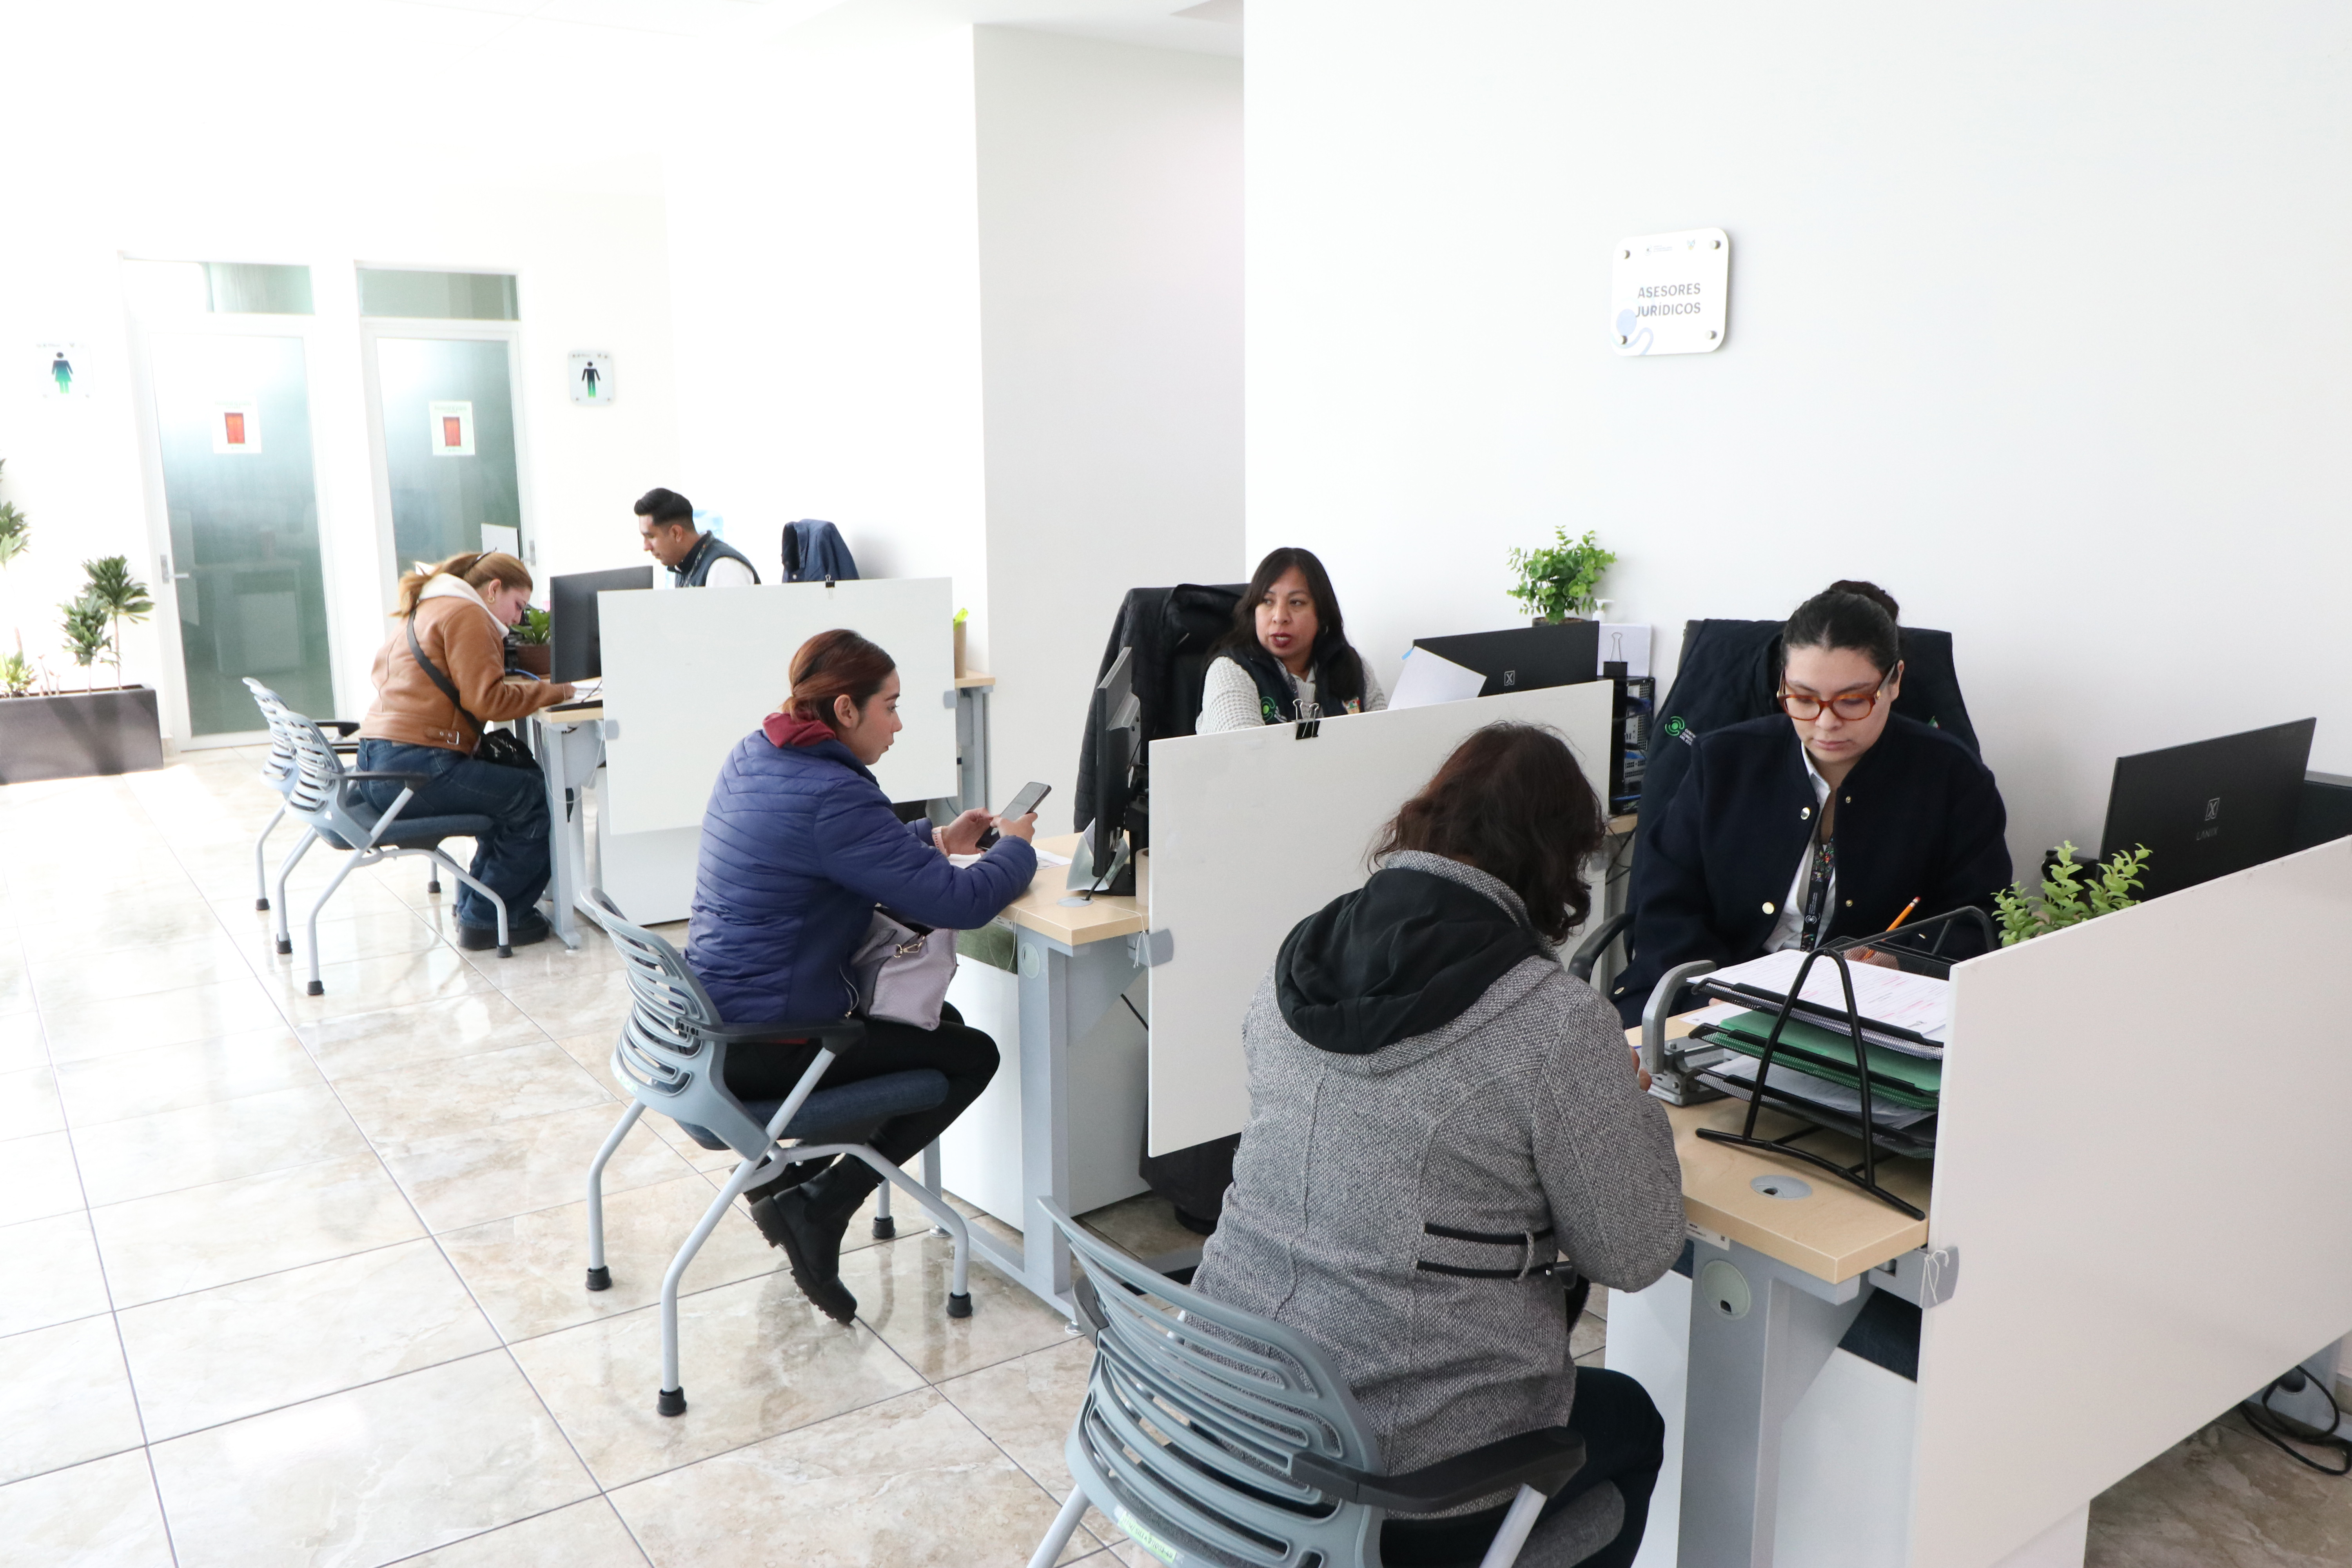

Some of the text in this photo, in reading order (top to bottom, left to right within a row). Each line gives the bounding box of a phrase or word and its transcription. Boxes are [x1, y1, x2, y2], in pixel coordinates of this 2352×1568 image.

[1637, 283, 1701, 299] ASESORES
[1635, 301, 1701, 318] JURÍDICOS
[2196, 826, 2219, 840] LANIX
